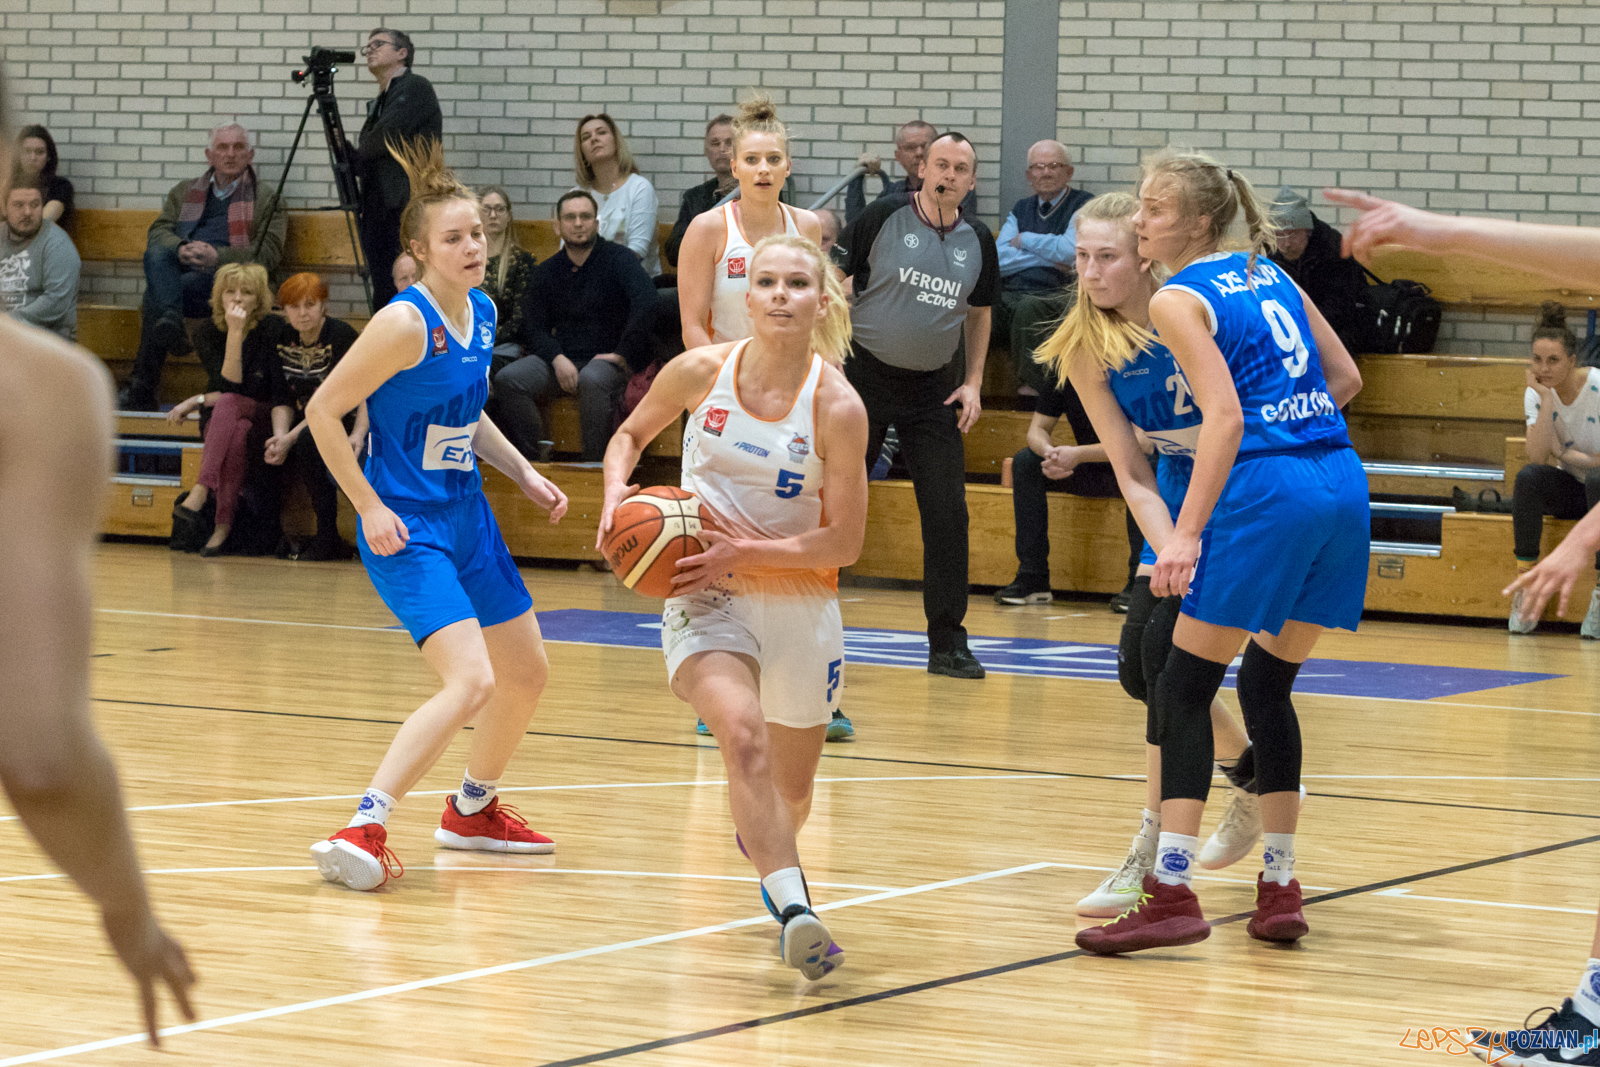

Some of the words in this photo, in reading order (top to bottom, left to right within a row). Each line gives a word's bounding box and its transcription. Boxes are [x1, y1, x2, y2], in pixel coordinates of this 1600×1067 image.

[898, 266, 962, 298] VERONI
[916, 290, 957, 310] active
[1260, 298, 1310, 379] 9
[739, 441, 771, 458] PROTON
[774, 468, 806, 499] 5
[826, 657, 842, 703] 5
